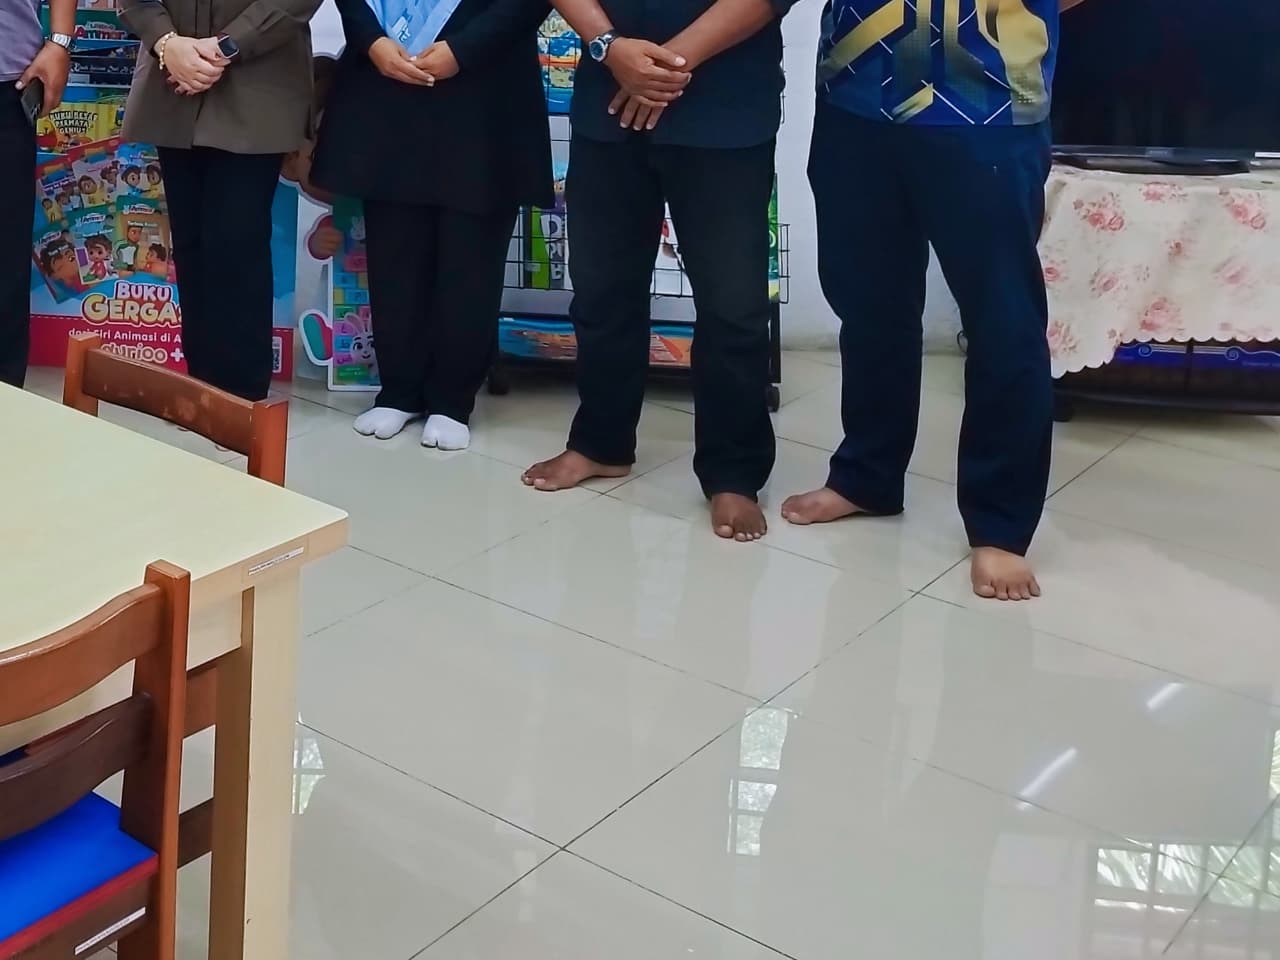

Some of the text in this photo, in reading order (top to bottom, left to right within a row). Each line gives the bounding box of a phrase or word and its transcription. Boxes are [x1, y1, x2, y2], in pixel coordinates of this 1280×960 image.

[116, 281, 171, 302] BUKU
[83, 293, 181, 324] GERGA
[114, 331, 157, 342] Animasi
[160, 332, 171, 342] di
[173, 334, 182, 342] A
